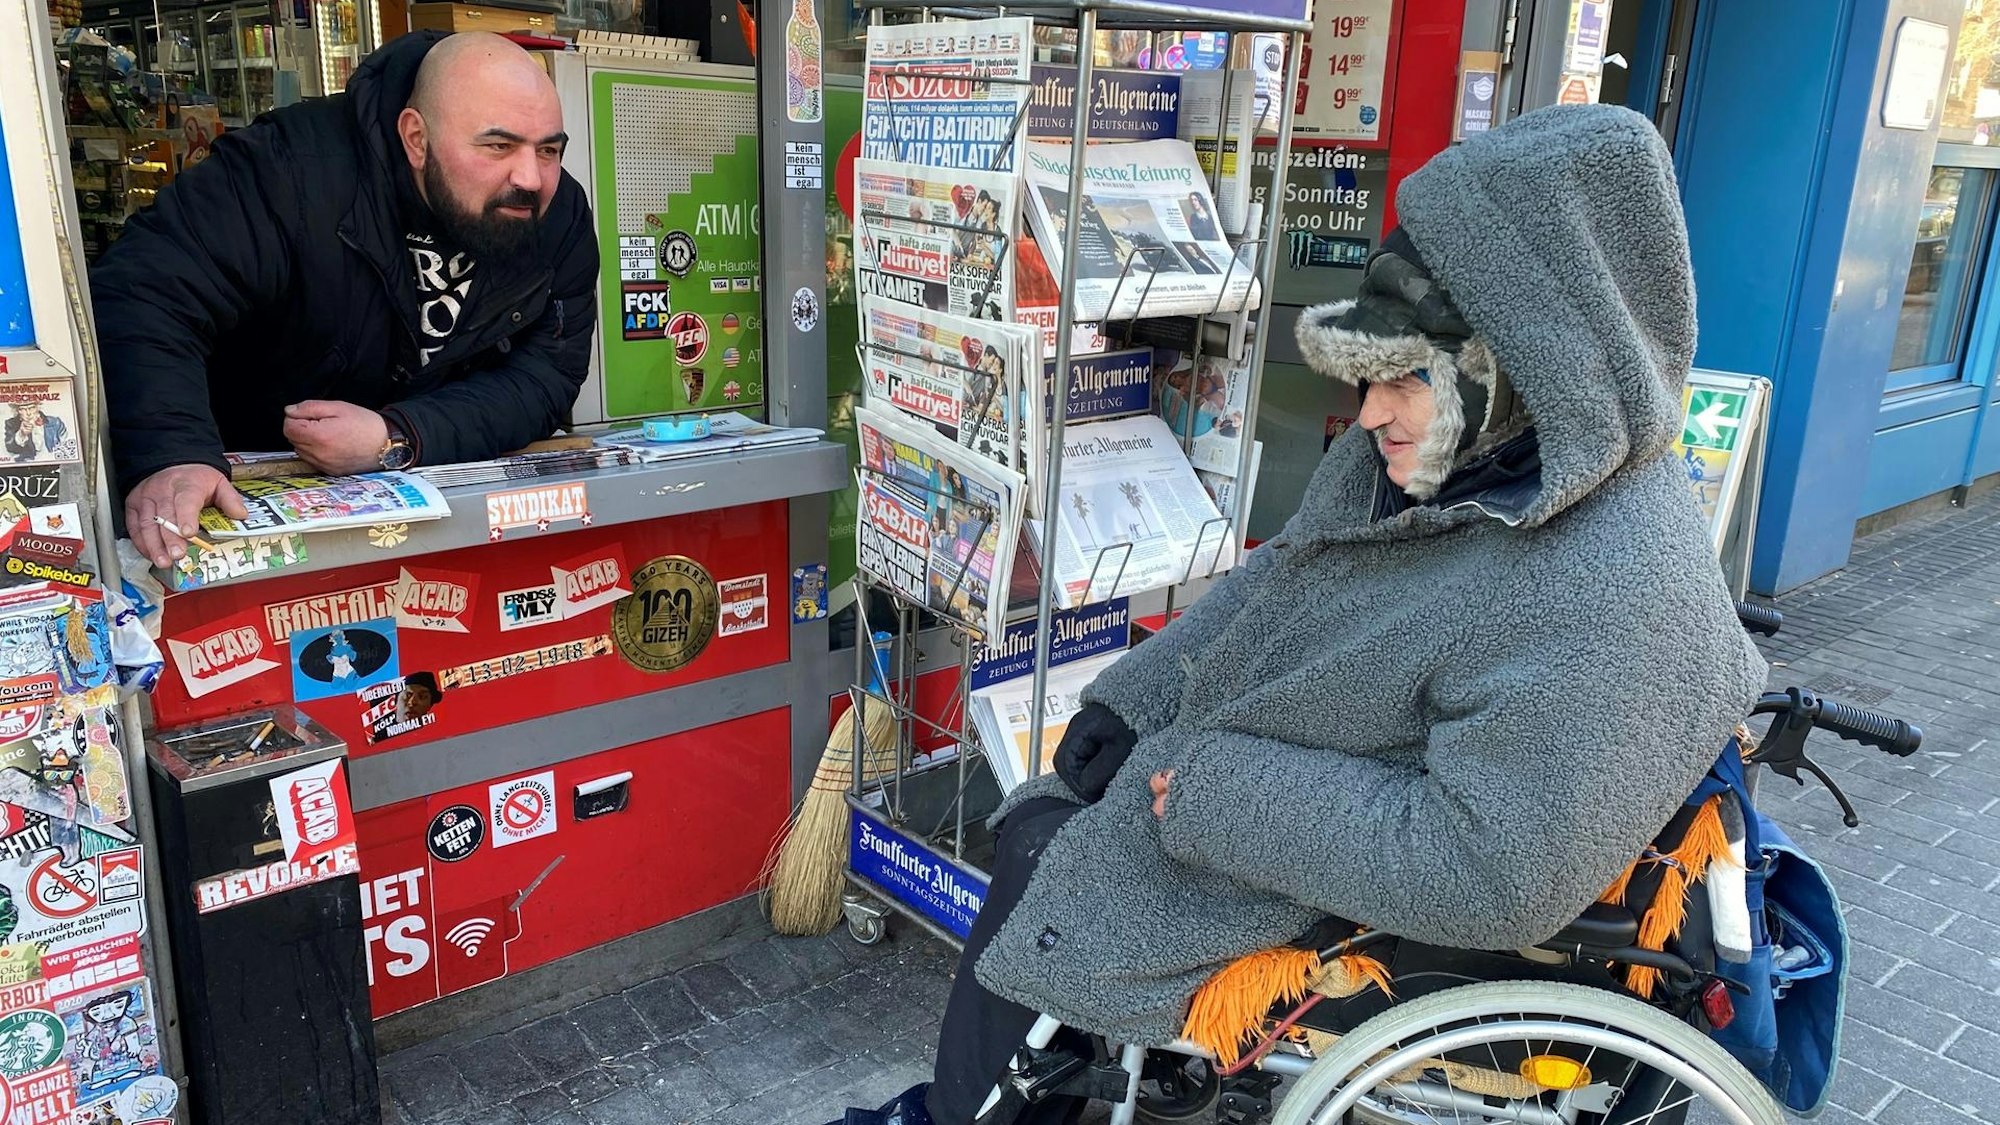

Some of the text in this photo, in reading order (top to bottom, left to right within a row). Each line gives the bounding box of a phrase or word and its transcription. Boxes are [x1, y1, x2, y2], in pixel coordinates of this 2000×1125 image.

[1094, 79, 1178, 116] Allgemeine
[1092, 119, 1160, 132] DEUTSCHLAND
[787, 154, 820, 165] mensch
[795, 143, 813, 153] kein
[794, 166, 806, 176] ist
[1127, 163, 1192, 186] Zeitung
[796, 178, 815, 189] egal
[1285, 183, 1370, 209] Sonntag
[1329, 211, 1366, 231] Uhr
[621, 247, 654, 257] mensch
[629, 236, 647, 246] kein
[629, 258, 640, 268] ist
[631, 269, 649, 280] egal
[696, 259, 715, 272] Alle
[625, 292, 668, 312] FCK
[625, 312, 670, 330] AFDP
[1071, 361, 1150, 398] Allgemeine
[1096, 435, 1153, 458] Allgemeine
[488, 485, 585, 523] SYNDIKAT
[869, 493, 928, 549] SABAH
[18, 537, 74, 555] MOODS
[23, 562, 90, 586] Spikeball
[566, 558, 620, 602] ACAB
[665, 561, 706, 586] YEARS
[404, 580, 468, 616] ACAB
[643, 626, 689, 644] GIZEH
[1053, 607, 1127, 648] Allgemeine
[191, 625, 262, 678] ACAB
[988, 636, 1112, 679] ZEITUNG DEUTSCHLAND
[386, 717, 421, 737] NORMAL
[293, 776, 338, 846] ACAB
[495, 804, 503, 826] OHNE
[433, 816, 477, 847] KETTEN
[446, 832, 473, 853] FETT
[502, 826, 524, 837] OHNE
[859, 821, 931, 882] Frankfurter
[200, 844, 357, 910] REVOLTE
[16, 906, 131, 943] Fahrräder abstellen
[49, 922, 106, 943] verboten!
[47, 954, 70, 967] WIR
[73, 937, 134, 958] BRAUCHEN
[29, 1073, 70, 1099] GANZE
